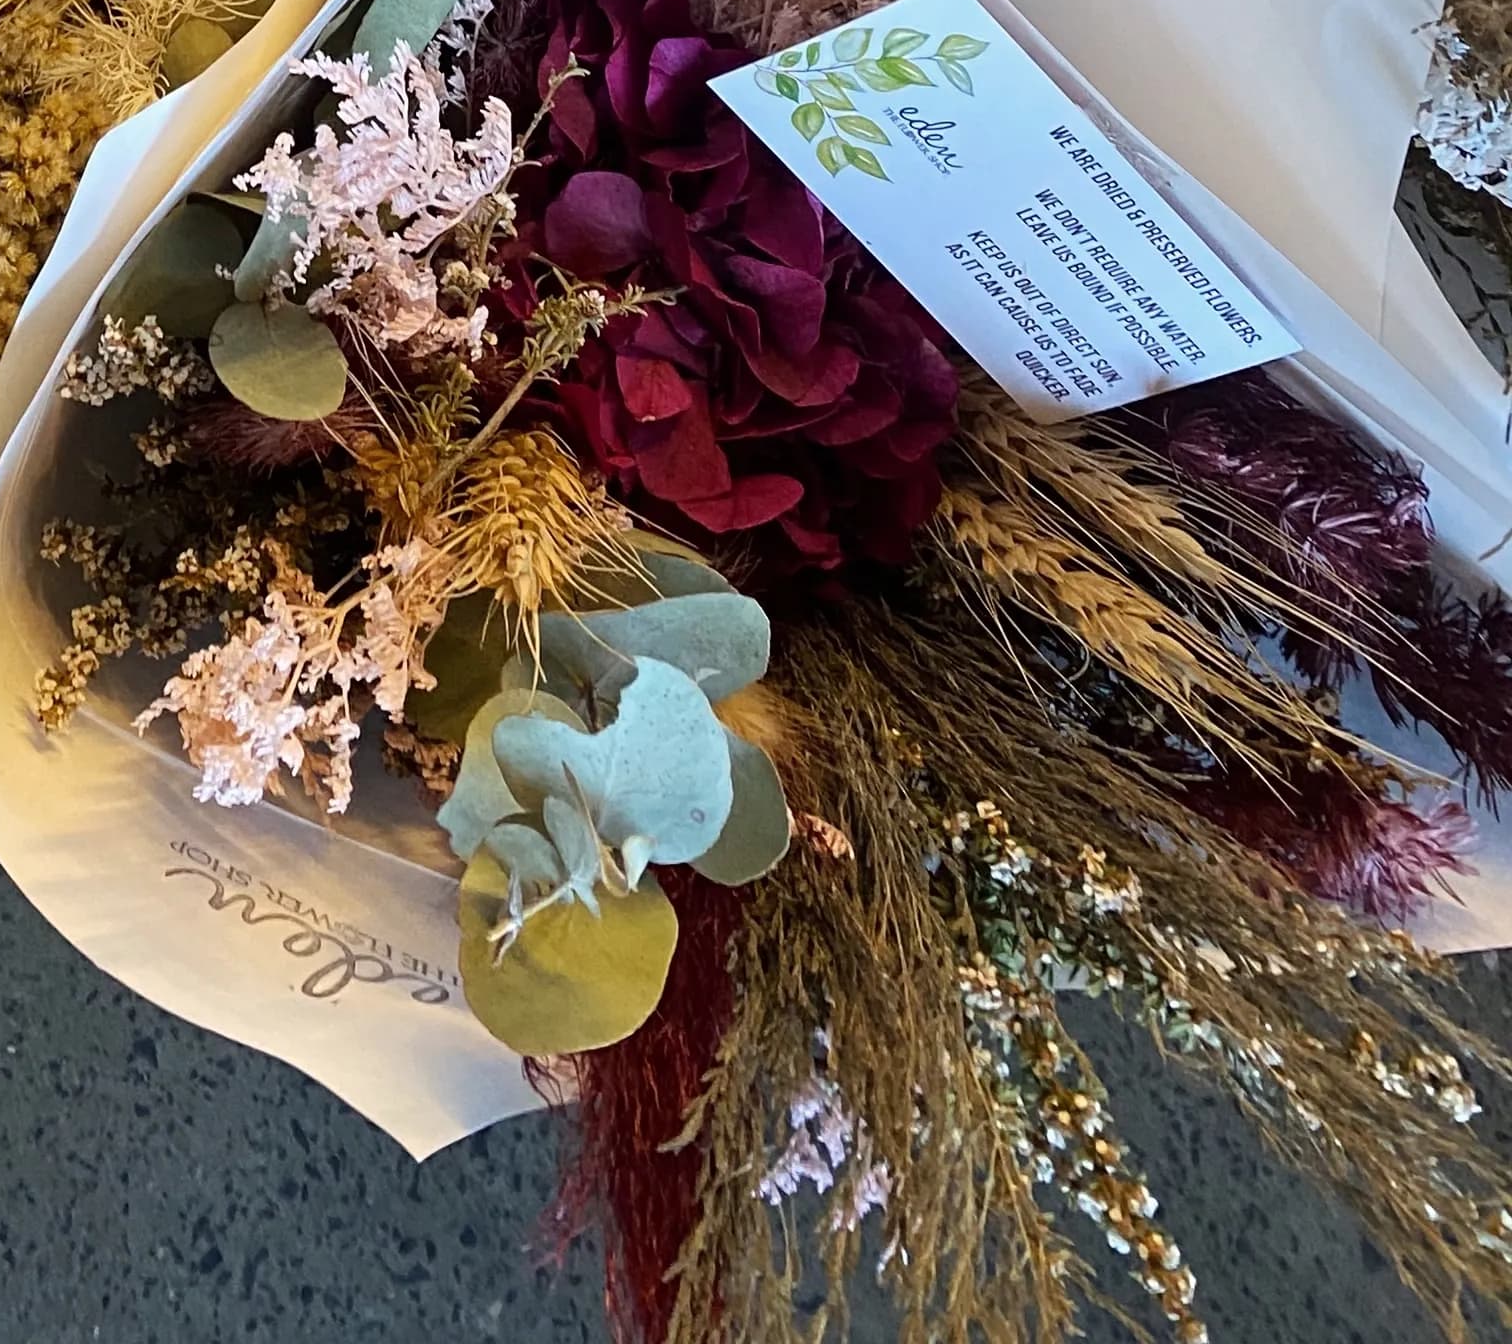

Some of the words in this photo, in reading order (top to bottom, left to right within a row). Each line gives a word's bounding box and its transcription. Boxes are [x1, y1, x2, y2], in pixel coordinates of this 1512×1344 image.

[899, 107, 964, 168] eden
[1049, 125, 1079, 149] WE
[1068, 148, 1103, 174] ARE
[1091, 172, 1136, 210] DRIED
[1126, 209, 1146, 220] &
[1016, 208, 1062, 246] LEAVE
[1052, 245, 1076, 262] US
[1067, 262, 1115, 303] BOUND
[1105, 302, 1129, 313] IF
[1035, 189, 1064, 211] WE
[1053, 209, 1098, 245] DON'T
[1086, 245, 1145, 296] REQUIRE
[1132, 296, 1169, 319] ANY
[1158, 320, 1206, 365] WATER.
[1135, 220, 1210, 289] PRESERVED
[944, 243, 970, 259] AS
[961, 258, 984, 271] IT
[974, 272, 1007, 297] CAN
[998, 296, 1043, 335] CAUSE
[1033, 334, 1058, 351] US
[1049, 350, 1074, 367] TO
[1063, 367, 1103, 398] FADE
[967, 230, 1006, 260] KEEP
[998, 260, 1022, 278] US
[1014, 278, 1047, 301] OUT
[1036, 302, 1062, 316] OF
[1050, 318, 1101, 358] DIRECT
[1199, 288, 1262, 348] FLOWERS.
[1015, 350, 1070, 402] QUICKER.
[170, 840, 253, 887] SHOP
[164, 867, 450, 1004] eden
